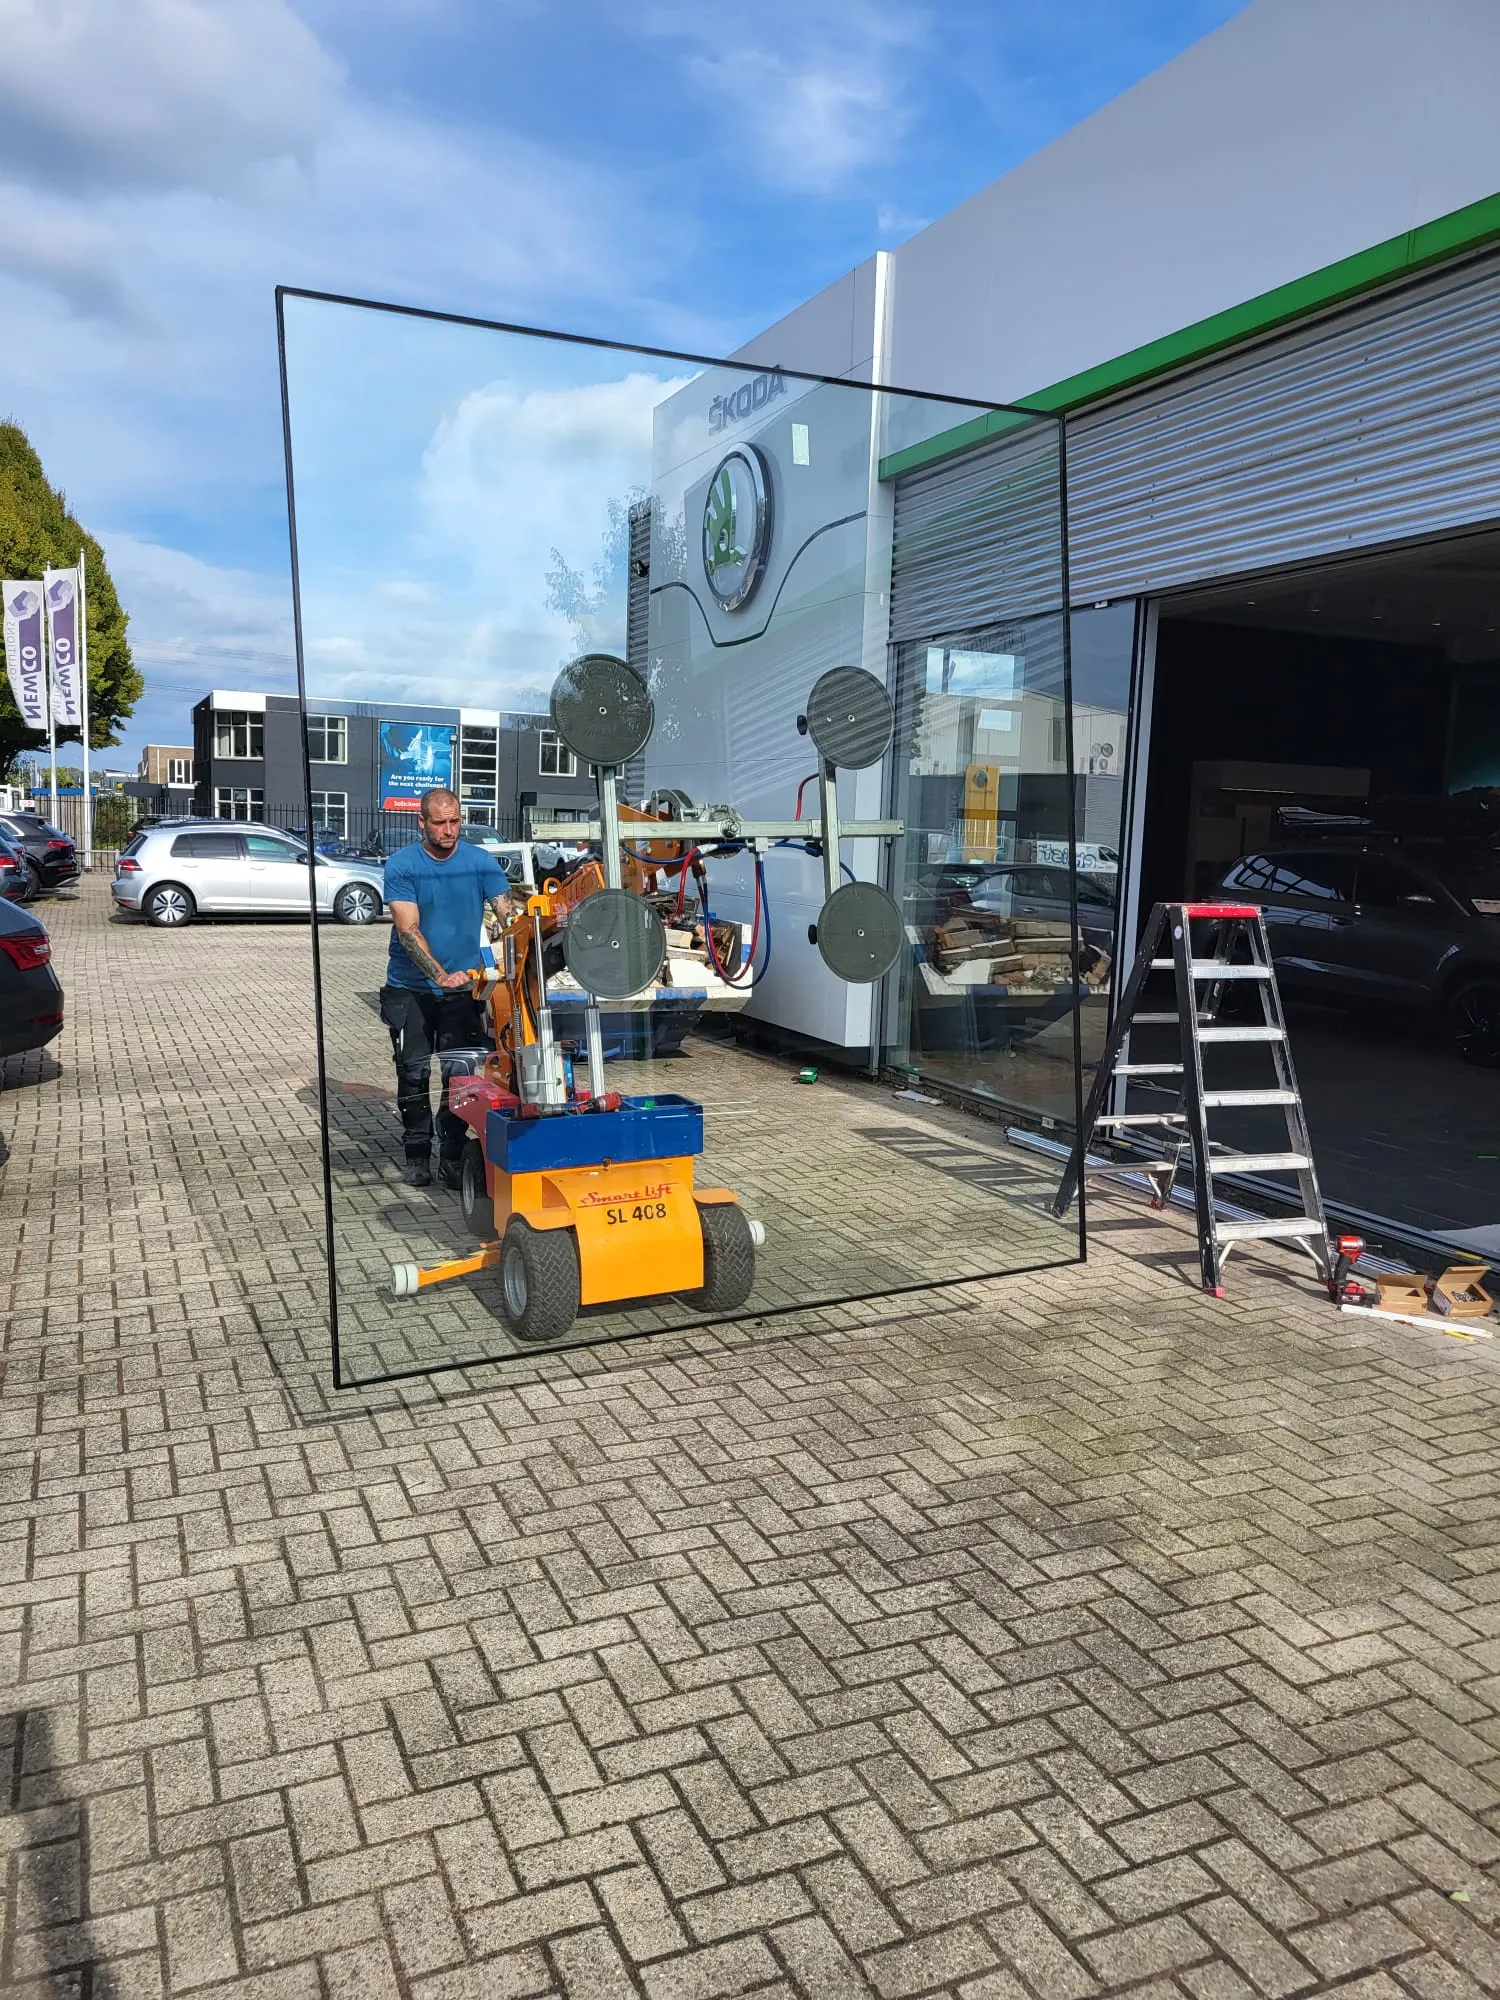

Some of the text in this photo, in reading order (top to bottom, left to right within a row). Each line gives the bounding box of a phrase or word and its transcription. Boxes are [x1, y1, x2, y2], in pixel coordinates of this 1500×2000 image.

[707, 364, 786, 437] ŠKODA
[416, 775, 433, 783] ready
[580, 1190, 642, 1205] Smart
[606, 1202, 667, 1225] SL 408
